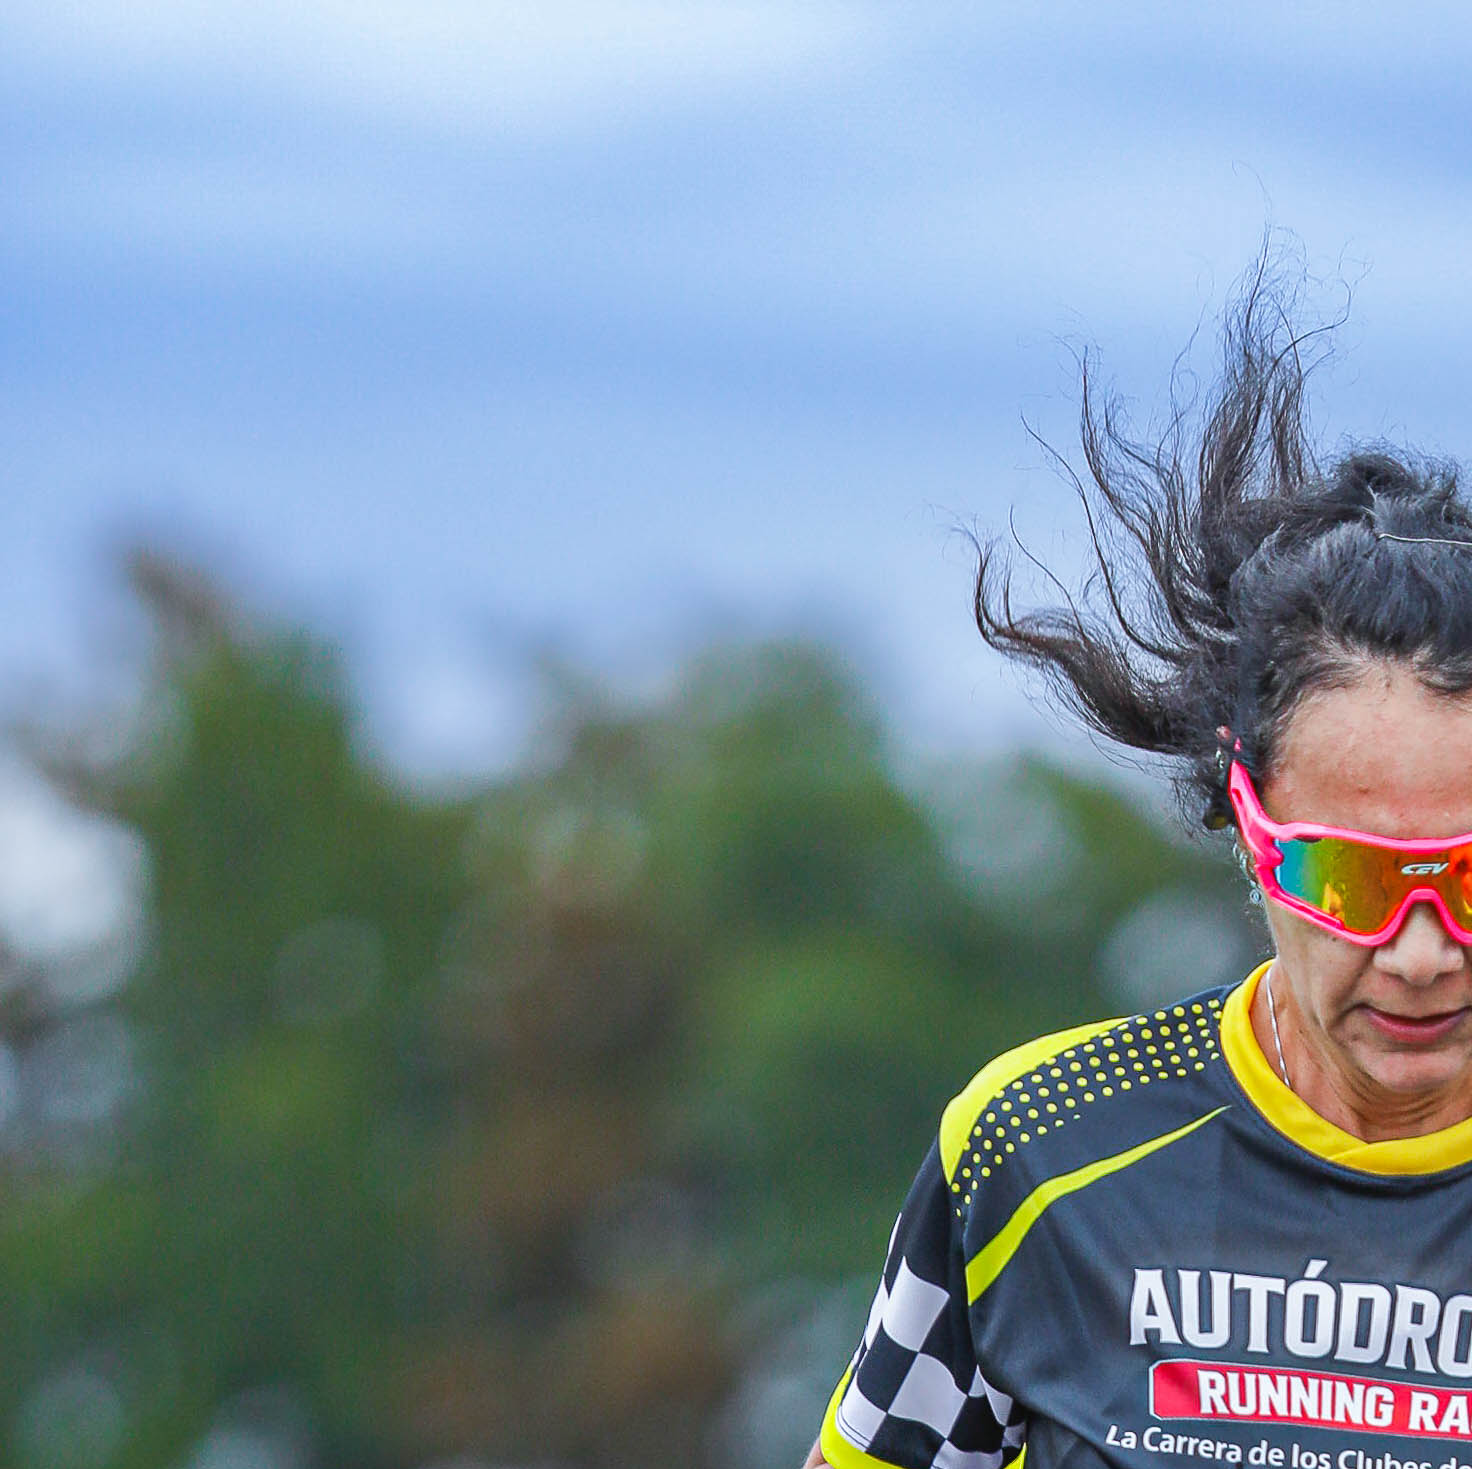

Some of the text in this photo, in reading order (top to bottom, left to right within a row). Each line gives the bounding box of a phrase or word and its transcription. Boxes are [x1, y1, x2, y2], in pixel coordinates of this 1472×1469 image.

[1197, 1369, 1395, 1428] RUNNING
[1105, 1424, 1137, 1450] La
[1142, 1426, 1243, 1464] Carrera
[1248, 1439, 1285, 1467] de
